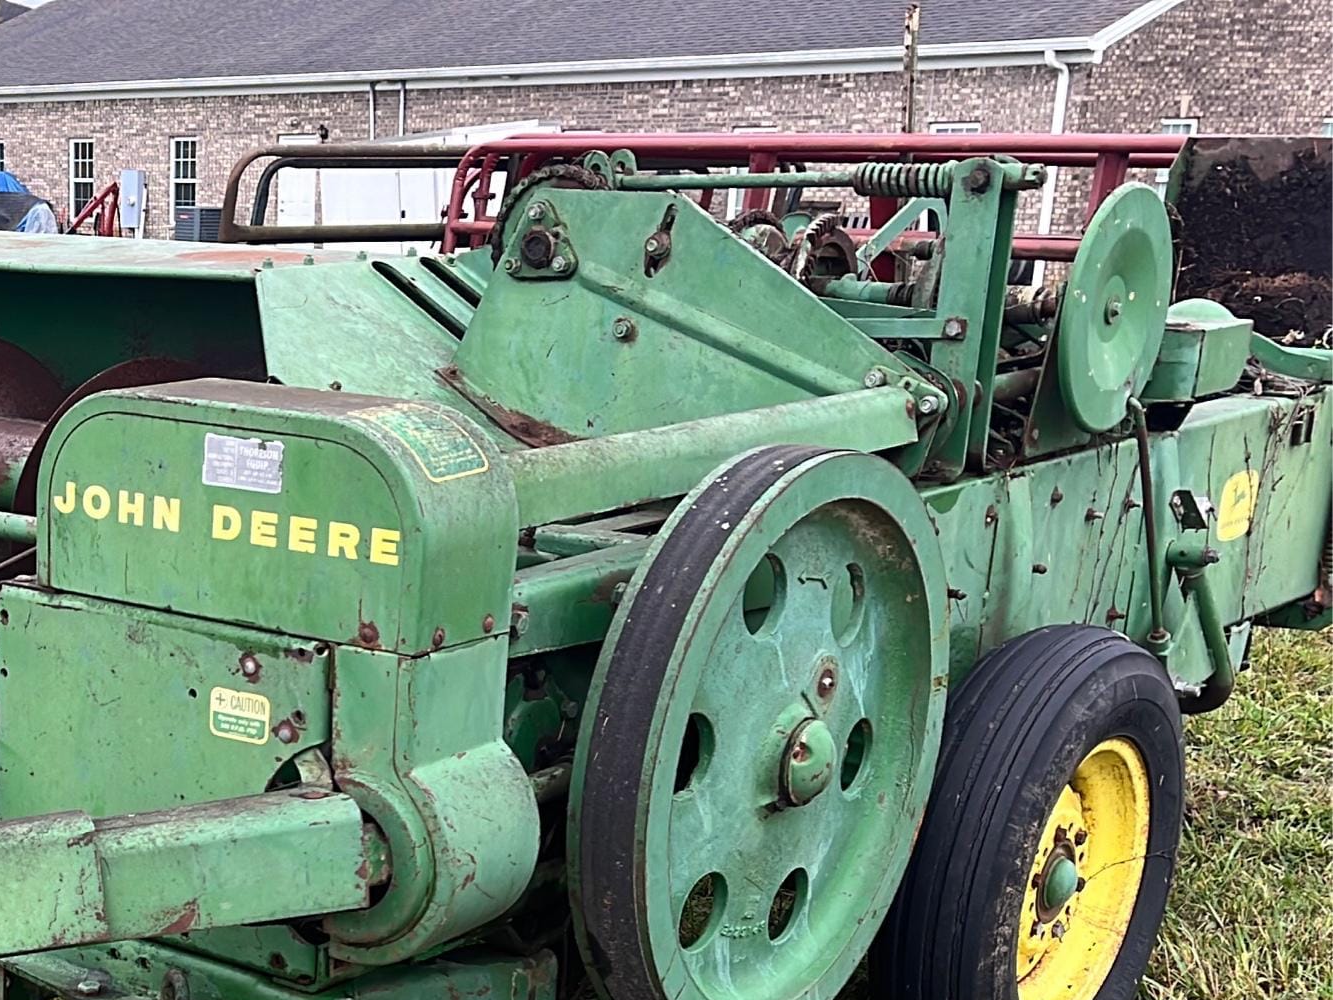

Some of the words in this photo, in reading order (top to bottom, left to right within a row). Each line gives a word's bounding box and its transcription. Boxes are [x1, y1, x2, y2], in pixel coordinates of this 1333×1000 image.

[53, 481, 181, 533] JOHN
[211, 504, 401, 567] DEERE
[230, 695, 266, 715] CAUTION
